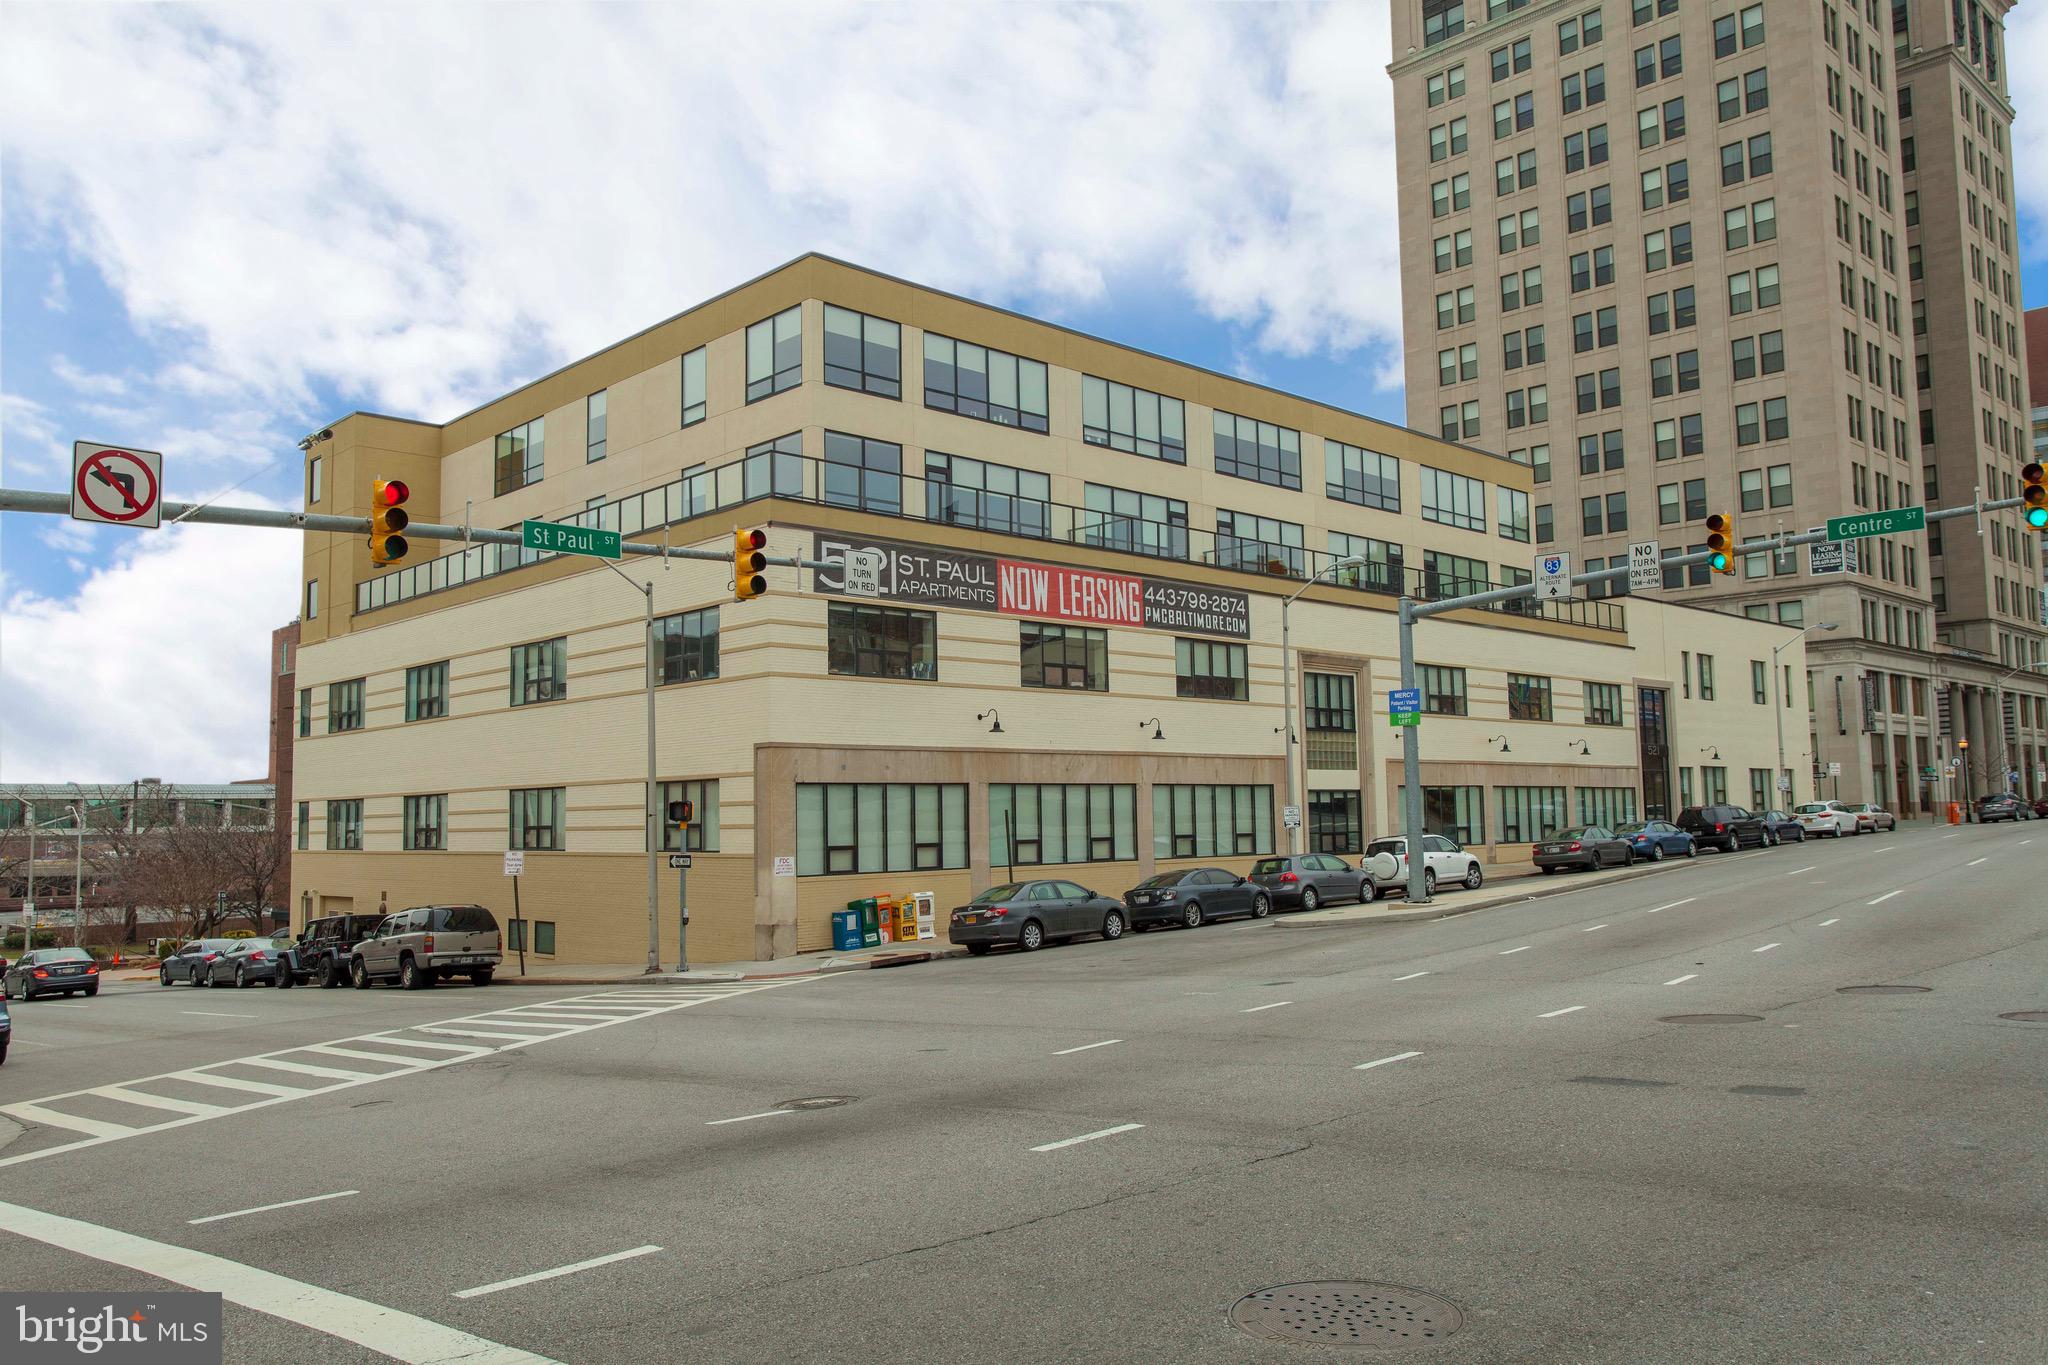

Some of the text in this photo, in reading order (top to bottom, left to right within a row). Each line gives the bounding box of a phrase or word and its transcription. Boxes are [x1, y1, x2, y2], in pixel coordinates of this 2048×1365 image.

[1839, 512, 1917, 535] Centre ST
[534, 528, 615, 551] St Paul ST
[1634, 545, 1652, 557] NO
[1817, 544, 1836, 552] NOW
[856, 556, 868, 566] NO
[1812, 551, 1842, 561] LEASING
[1546, 560, 1559, 571] 83
[1632, 557, 1656, 567] TURN
[853, 568, 872, 579] TURN
[899, 554, 931, 578] ST.
[936, 559, 995, 586] PAUL
[1630, 567, 1658, 578] ON RED
[1540, 573, 1567, 581] ALTERNATE
[848, 580, 876, 592] ON RED
[899, 579, 996, 604] APARTMENTS
[1001, 565, 1140, 623] NOW LEASING
[1144, 586, 1247, 616] 443-798-2874
[1145, 606, 1247, 634] PMCBALTIMORE.COM
[1648, 745, 1660, 756] 521
